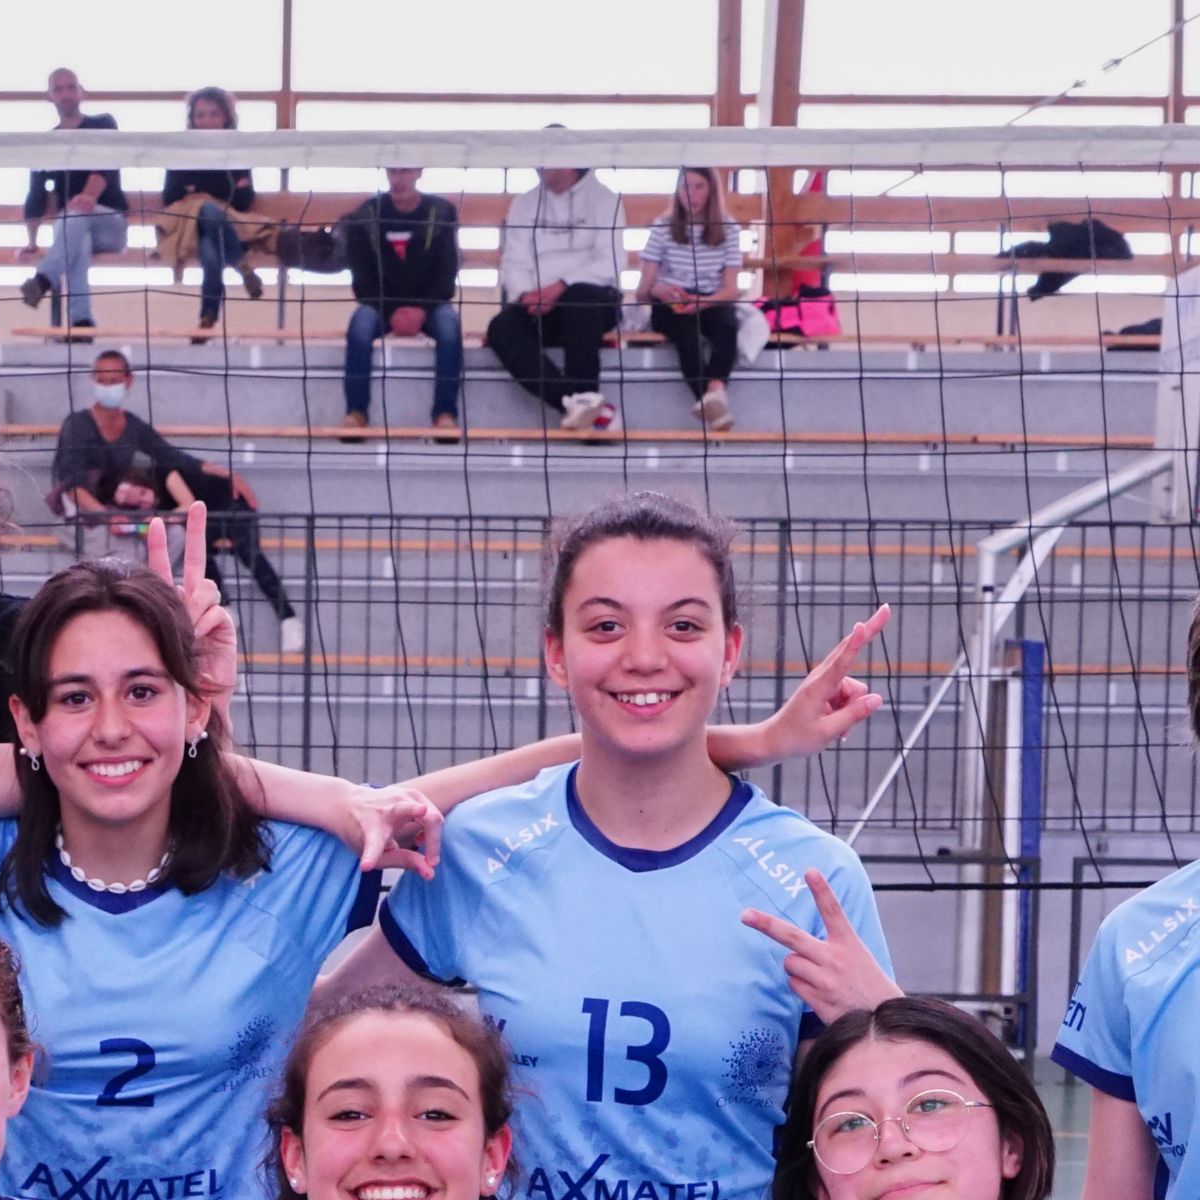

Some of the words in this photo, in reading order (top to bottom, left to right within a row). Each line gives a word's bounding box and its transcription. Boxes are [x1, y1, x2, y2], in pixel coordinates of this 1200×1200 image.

[487, 812, 559, 874] ALLSIX
[731, 836, 808, 898] ALLSIX
[1125, 899, 1200, 965] ALLSIX
[97, 1037, 156, 1107] 2
[582, 997, 672, 1106] 13
